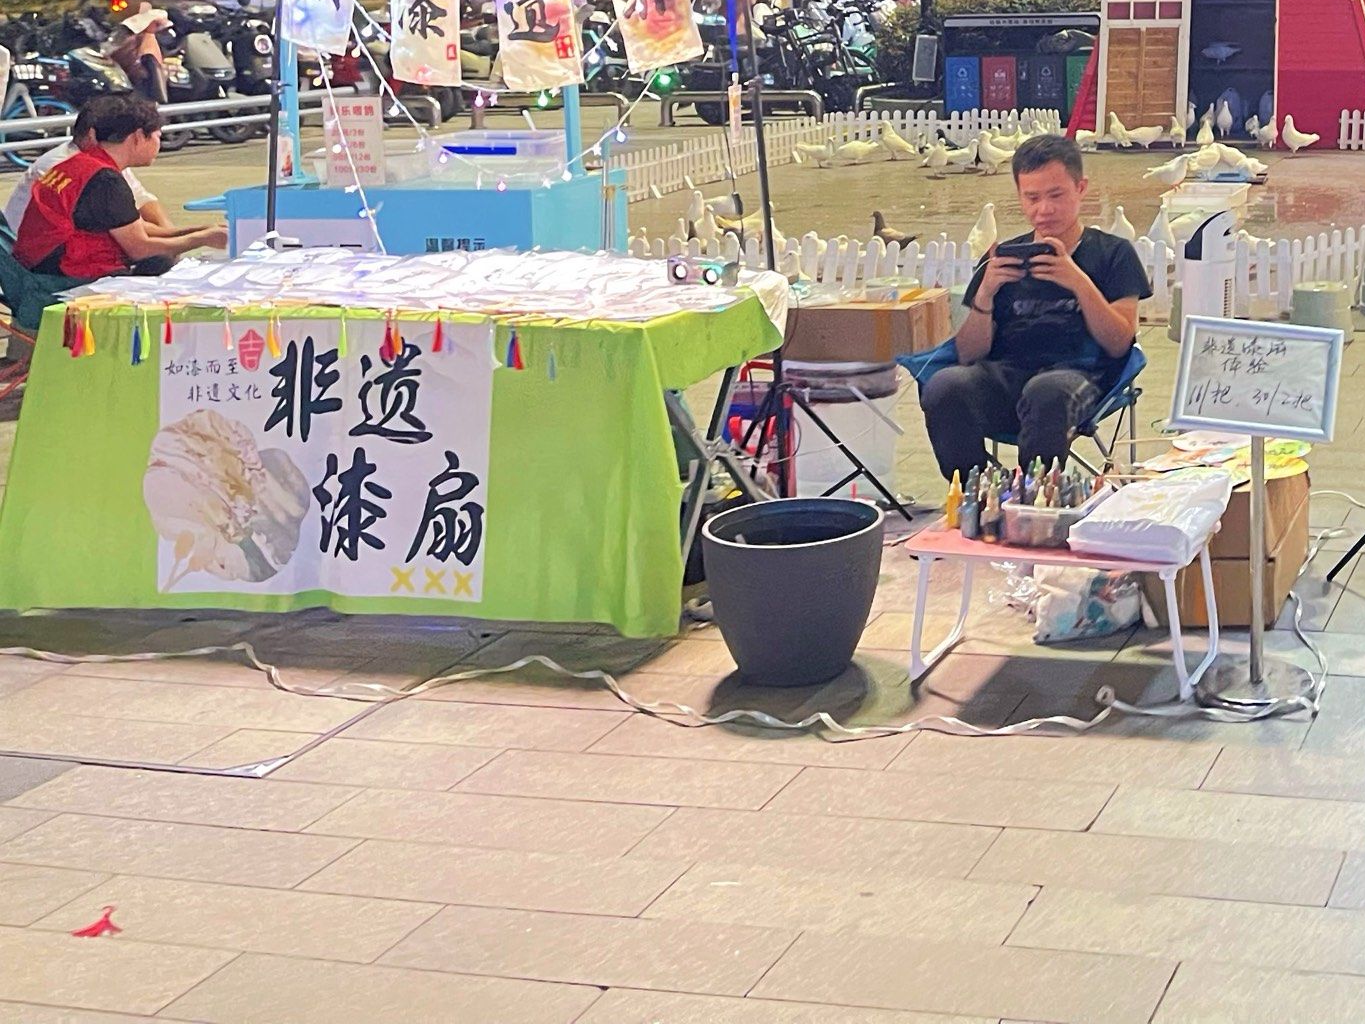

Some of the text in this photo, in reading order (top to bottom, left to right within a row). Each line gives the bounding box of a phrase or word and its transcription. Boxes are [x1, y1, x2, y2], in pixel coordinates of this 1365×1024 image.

[165, 357, 238, 376] 如漆而至
[187, 383, 261, 402] 非遗文化
[264, 336, 433, 444] 非遗
[313, 447, 484, 566] 漆扇
